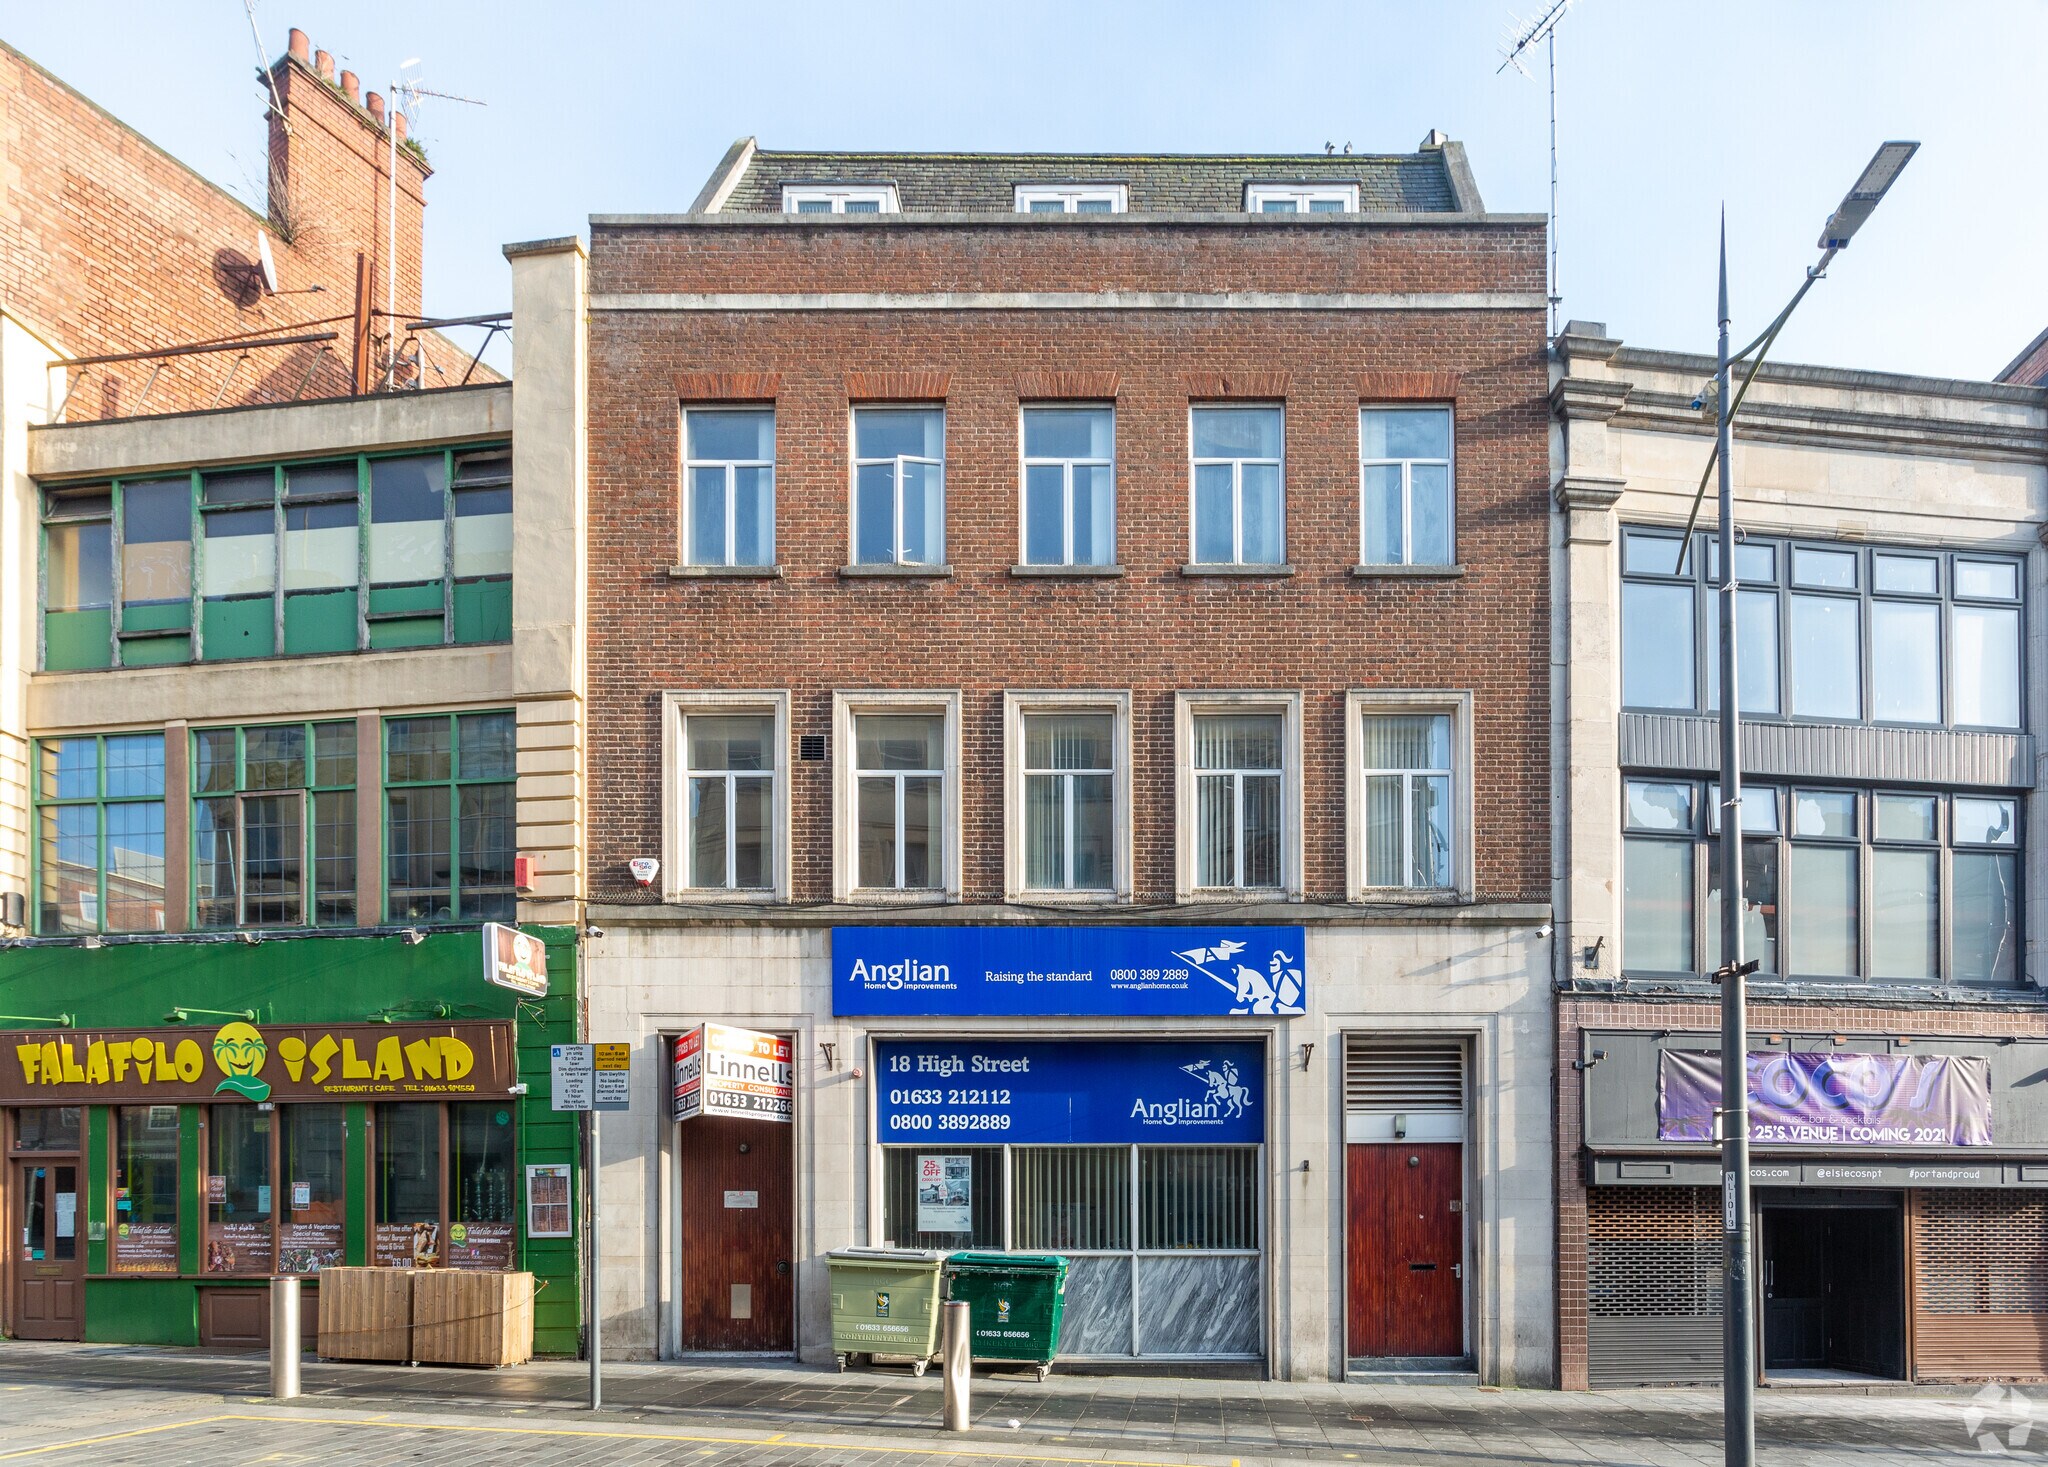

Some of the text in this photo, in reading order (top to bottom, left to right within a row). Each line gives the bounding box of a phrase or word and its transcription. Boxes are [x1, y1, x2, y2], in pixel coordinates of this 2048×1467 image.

[849, 959, 950, 990] Anglian
[985, 971, 1093, 984] Raising the standard
[1110, 969, 1189, 980] 0800 389 2889
[757, 1041, 770, 1055] TO
[773, 1044, 790, 1058] LET
[706, 1053, 792, 1086] Linnells
[890, 1055, 1030, 1077] 18 High Street
[324, 1085, 368, 1093] RESTAURANT
[375, 1084, 396, 1092] CAFE
[890, 1089, 1011, 1104] 01633 212112
[710, 1091, 792, 1112] 01633 212266
[1130, 1098, 1218, 1125] Anglian
[1780, 1115, 1804, 1123] music
[1809, 1114, 1826, 1123] bar
[1841, 1115, 1881, 1124] cocktails
[890, 1114, 1011, 1130] 0800 3892889
[1755, 1125, 1786, 1140] 25'S
[1790, 1126, 1839, 1140] VENUE
[1850, 1127, 1911, 1142] COMING
[1914, 1127, 1946, 1142] 2021
[923, 1169, 941, 1177] OFF
[1817, 1169, 1883, 1180] @elsiecosnpt
[1909, 1169, 1980, 1180] #portandproud
